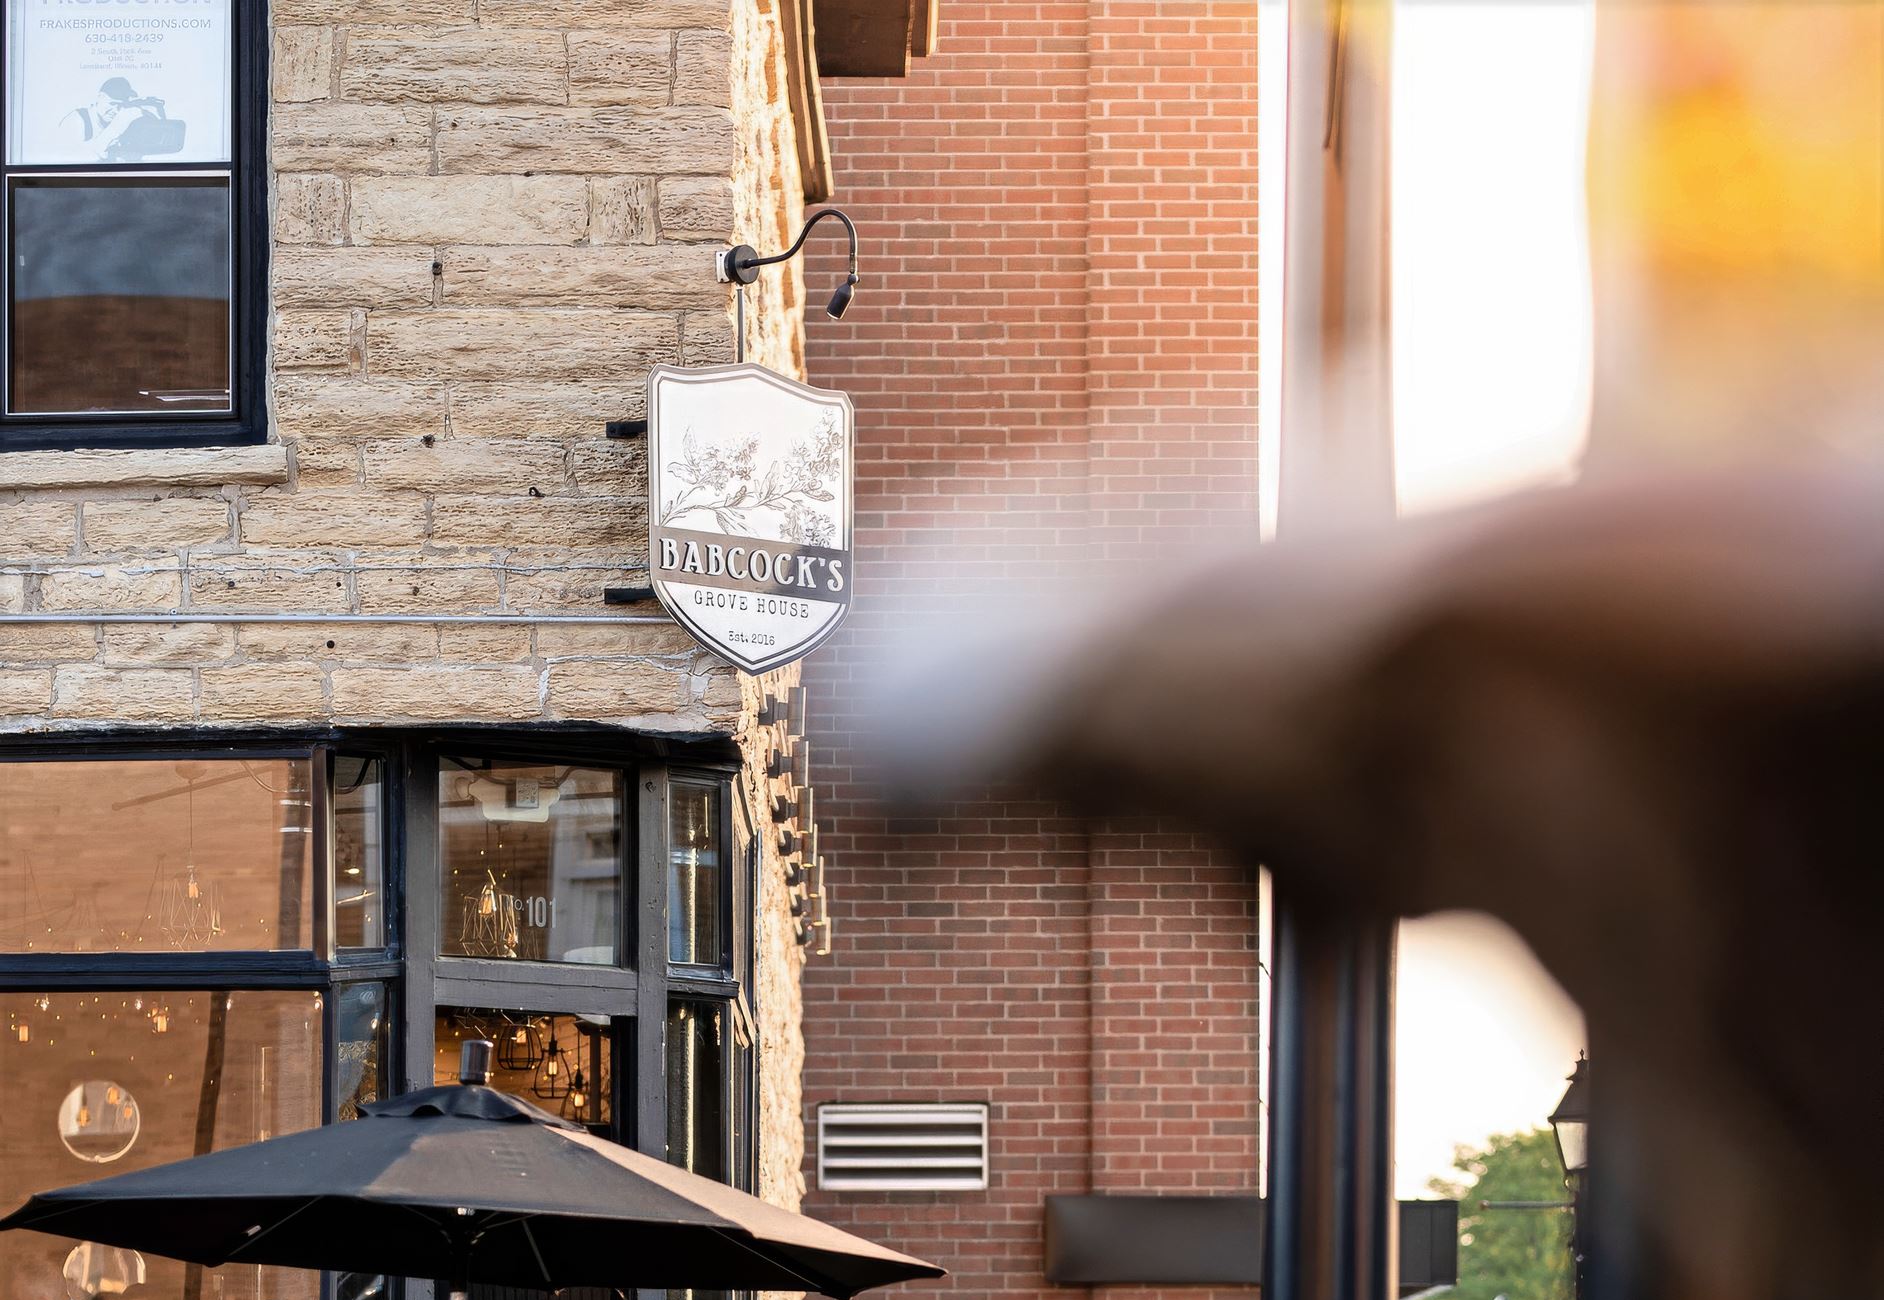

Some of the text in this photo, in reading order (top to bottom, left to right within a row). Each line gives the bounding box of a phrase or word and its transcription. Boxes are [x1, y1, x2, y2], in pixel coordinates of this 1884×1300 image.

[40, 19, 211, 29] FRAKESPRODUCTIONS.COM
[659, 538, 844, 592] BABCOCK'S
[694, 590, 809, 619] GROVE HOUSE
[728, 630, 775, 646] Est. 2016
[527, 896, 557, 928] 101
